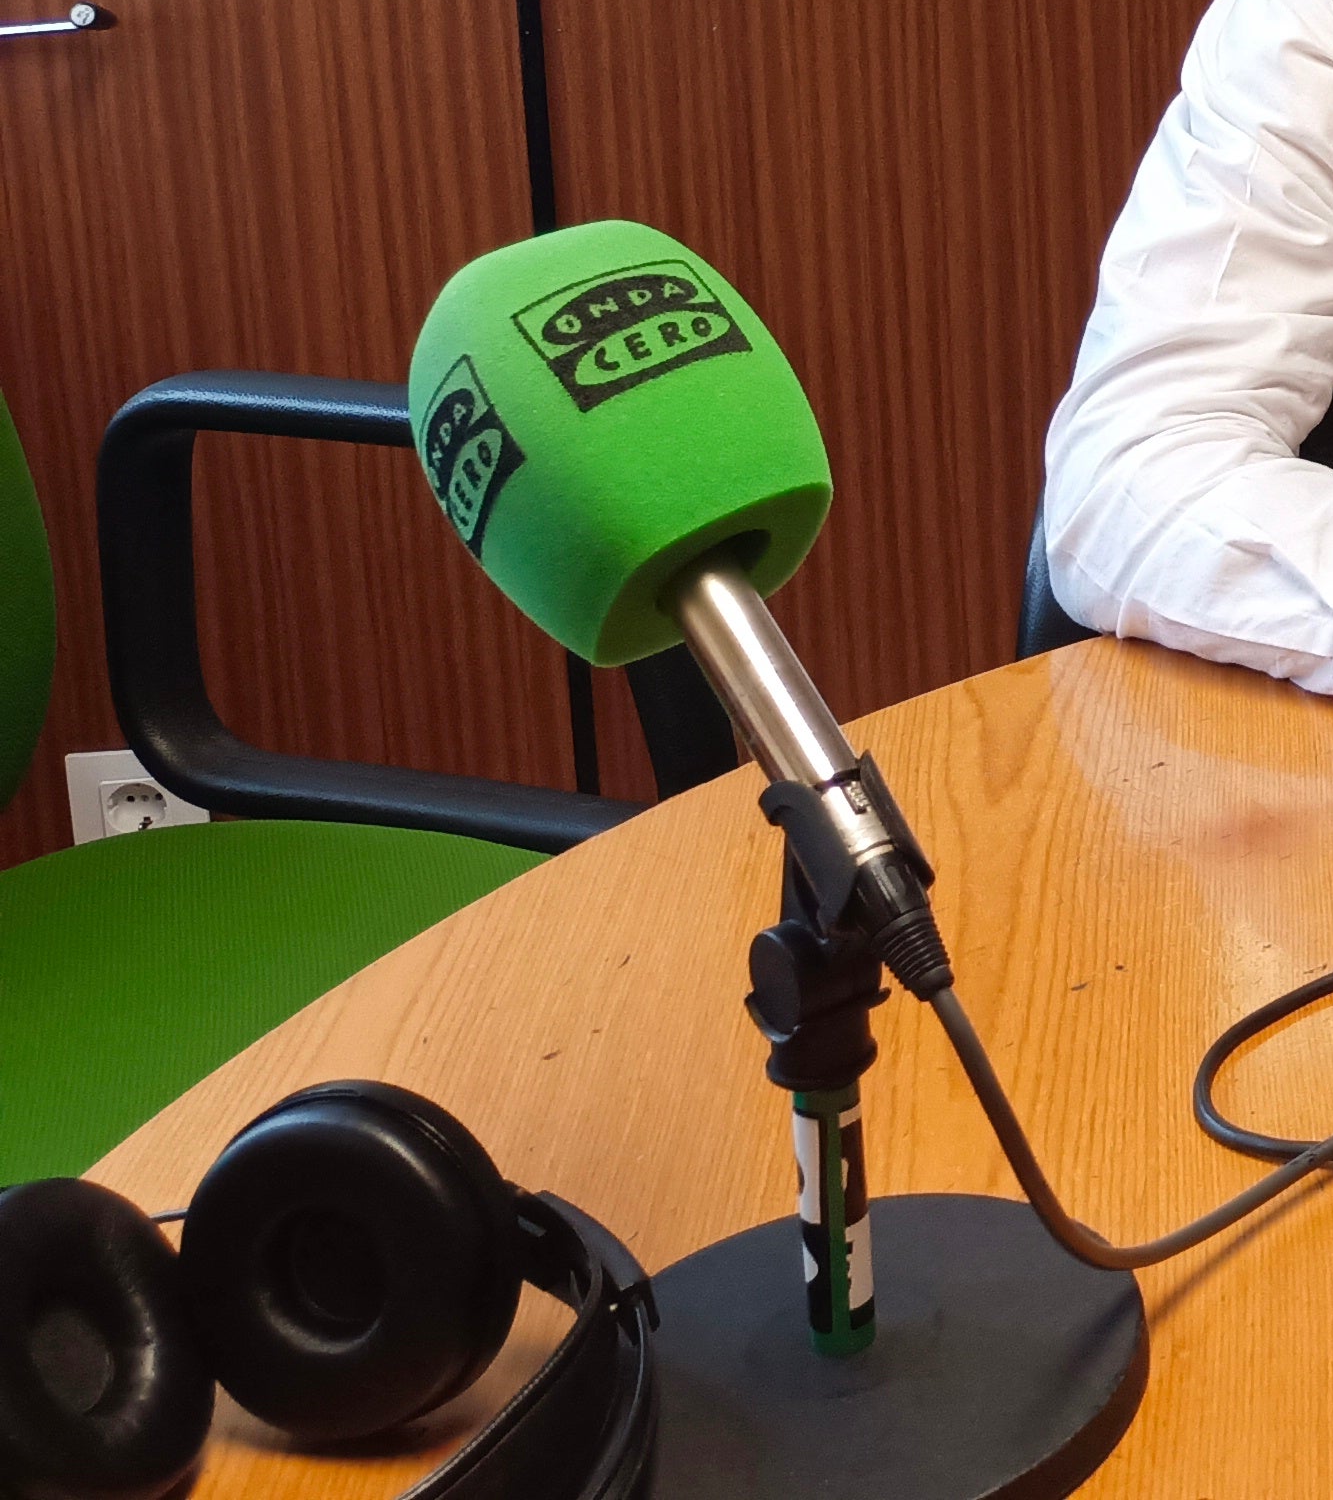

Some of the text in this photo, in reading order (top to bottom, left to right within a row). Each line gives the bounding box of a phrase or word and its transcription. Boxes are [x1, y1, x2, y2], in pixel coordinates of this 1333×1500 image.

[555, 281, 685, 334] ONDA
[594, 316, 712, 372] CERO
[446, 440, 492, 527] CERO
